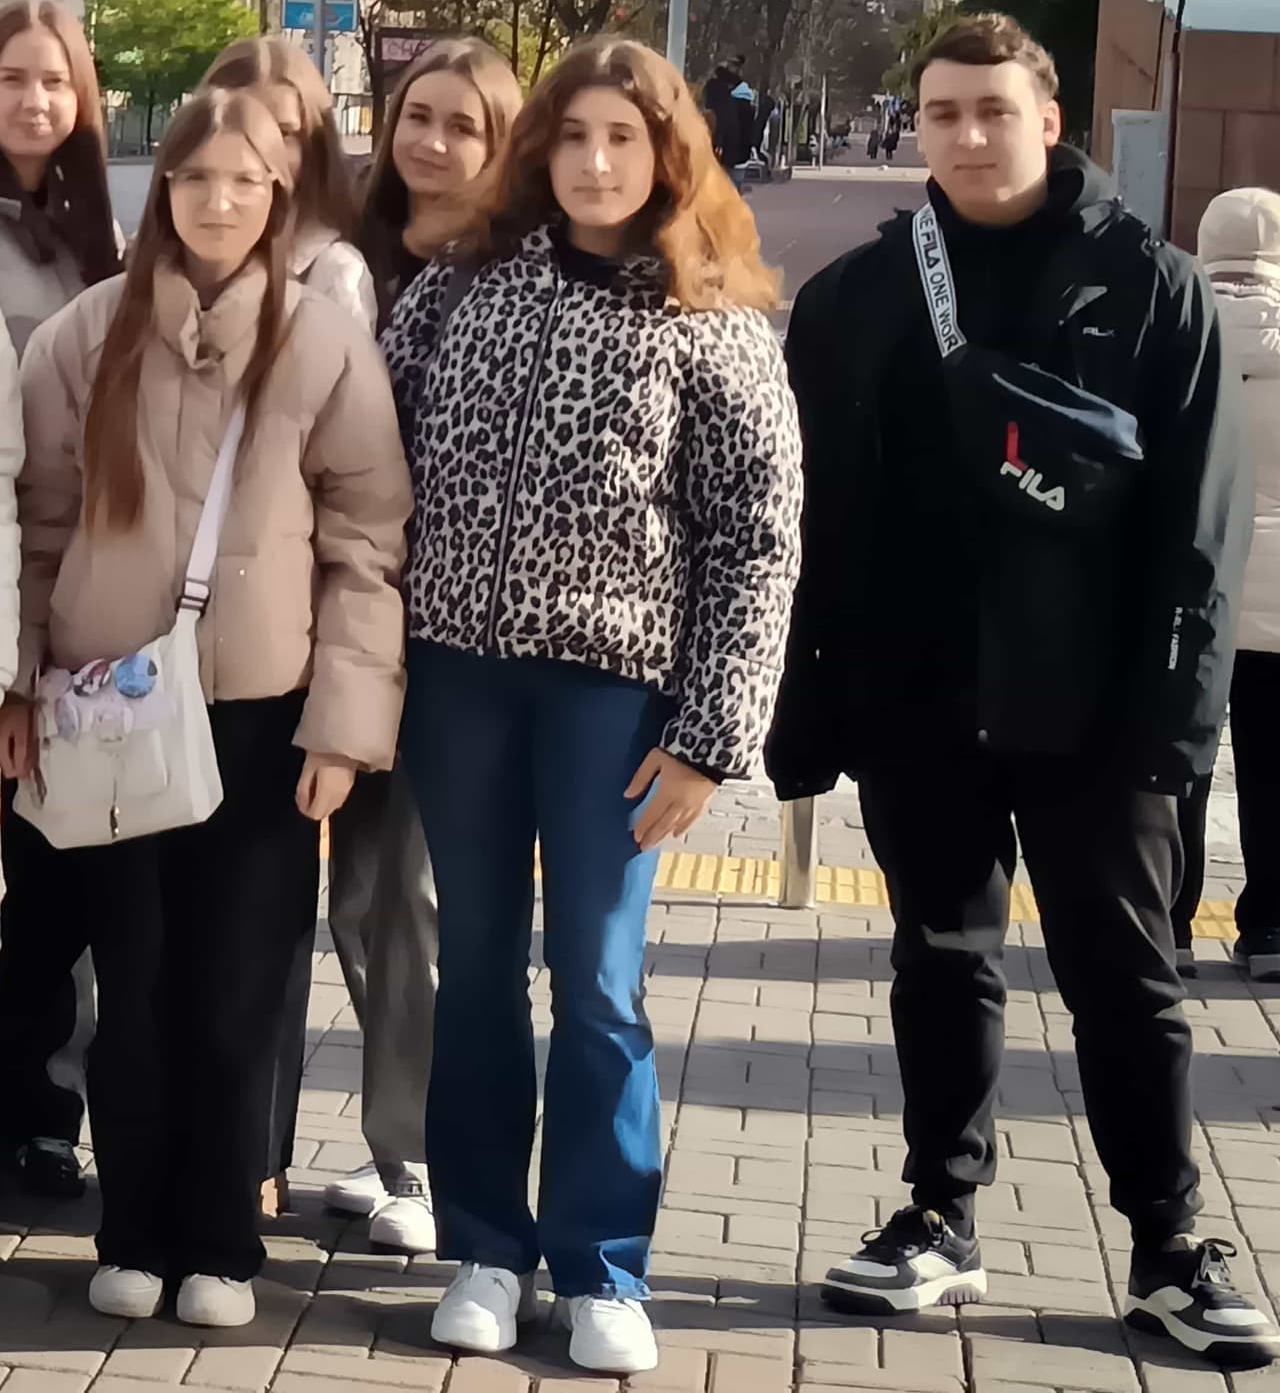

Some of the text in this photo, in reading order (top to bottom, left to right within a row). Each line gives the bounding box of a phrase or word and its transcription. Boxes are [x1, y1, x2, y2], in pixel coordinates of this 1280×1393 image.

[920, 229, 941, 269] FILA
[930, 272, 949, 308] ONE
[999, 421, 1065, 511] FILA
